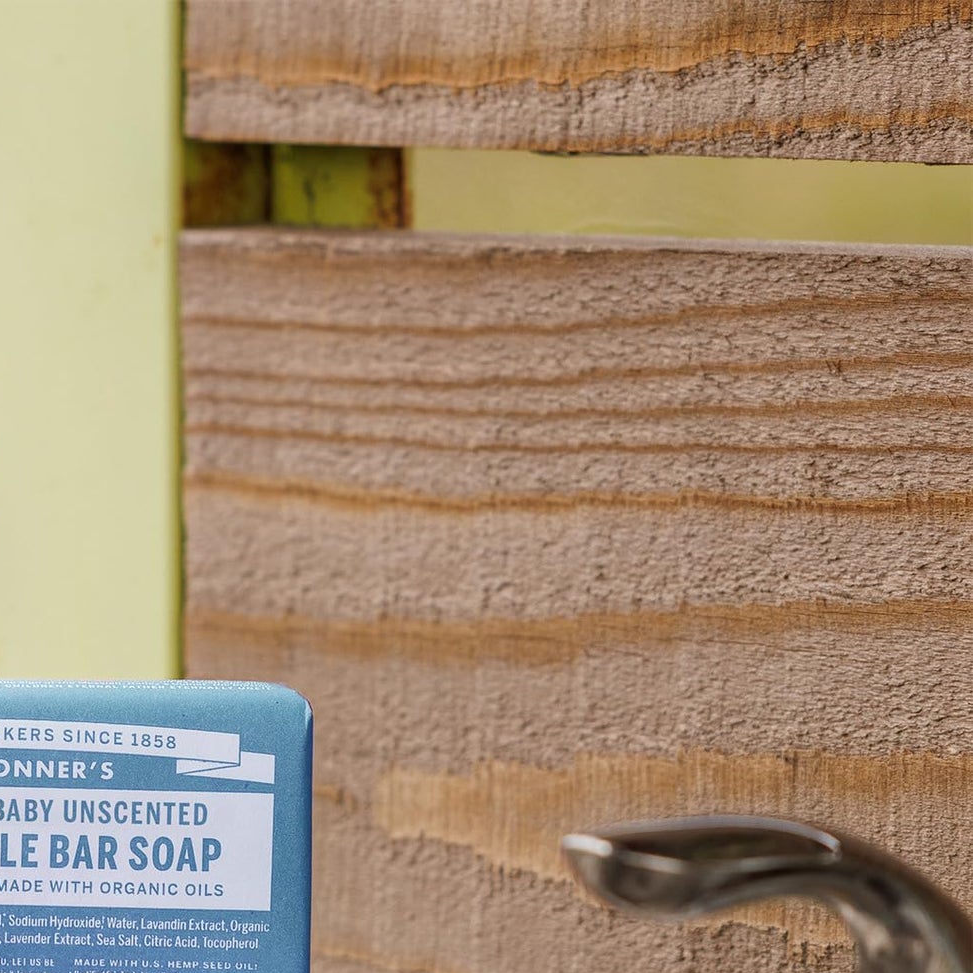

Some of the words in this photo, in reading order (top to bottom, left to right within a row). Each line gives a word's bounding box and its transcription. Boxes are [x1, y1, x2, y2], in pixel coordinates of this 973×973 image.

[63, 729, 123, 745] SINCE
[131, 733, 176, 749] 1858
[63, 799, 208, 826] UNSCENTED
[49, 834, 118, 870] BAR
[129, 836, 222, 872] SOAP
[50, 880, 93, 894] WITH
[100, 881, 178, 896] ORGANIC
[185, 883, 224, 896] OILS
[8, 915, 48, 927] Sodium
[107, 917, 139, 931] Water,
[141, 918, 187, 931] Lavandin
[189, 918, 228, 932] Extract,
[230, 920, 270, 934] Organic
[5, 932, 50, 945] Lavender
[54, 933, 94, 947] Extract,
[97, 934, 115, 946] Sea
[118, 934, 142, 948] Salt,
[144, 935, 173, 947] Citric
[202, 936, 259, 951] Tocopherol
[12, 957, 26, 966] LET
[30, 958, 41, 966] US
[44, 958, 55, 967] BE
[110, 959, 137, 967] WITH
[142, 960, 163, 968] U.S.
[167, 961, 199, 969] HEMP
[203, 961, 231, 969] SEED
